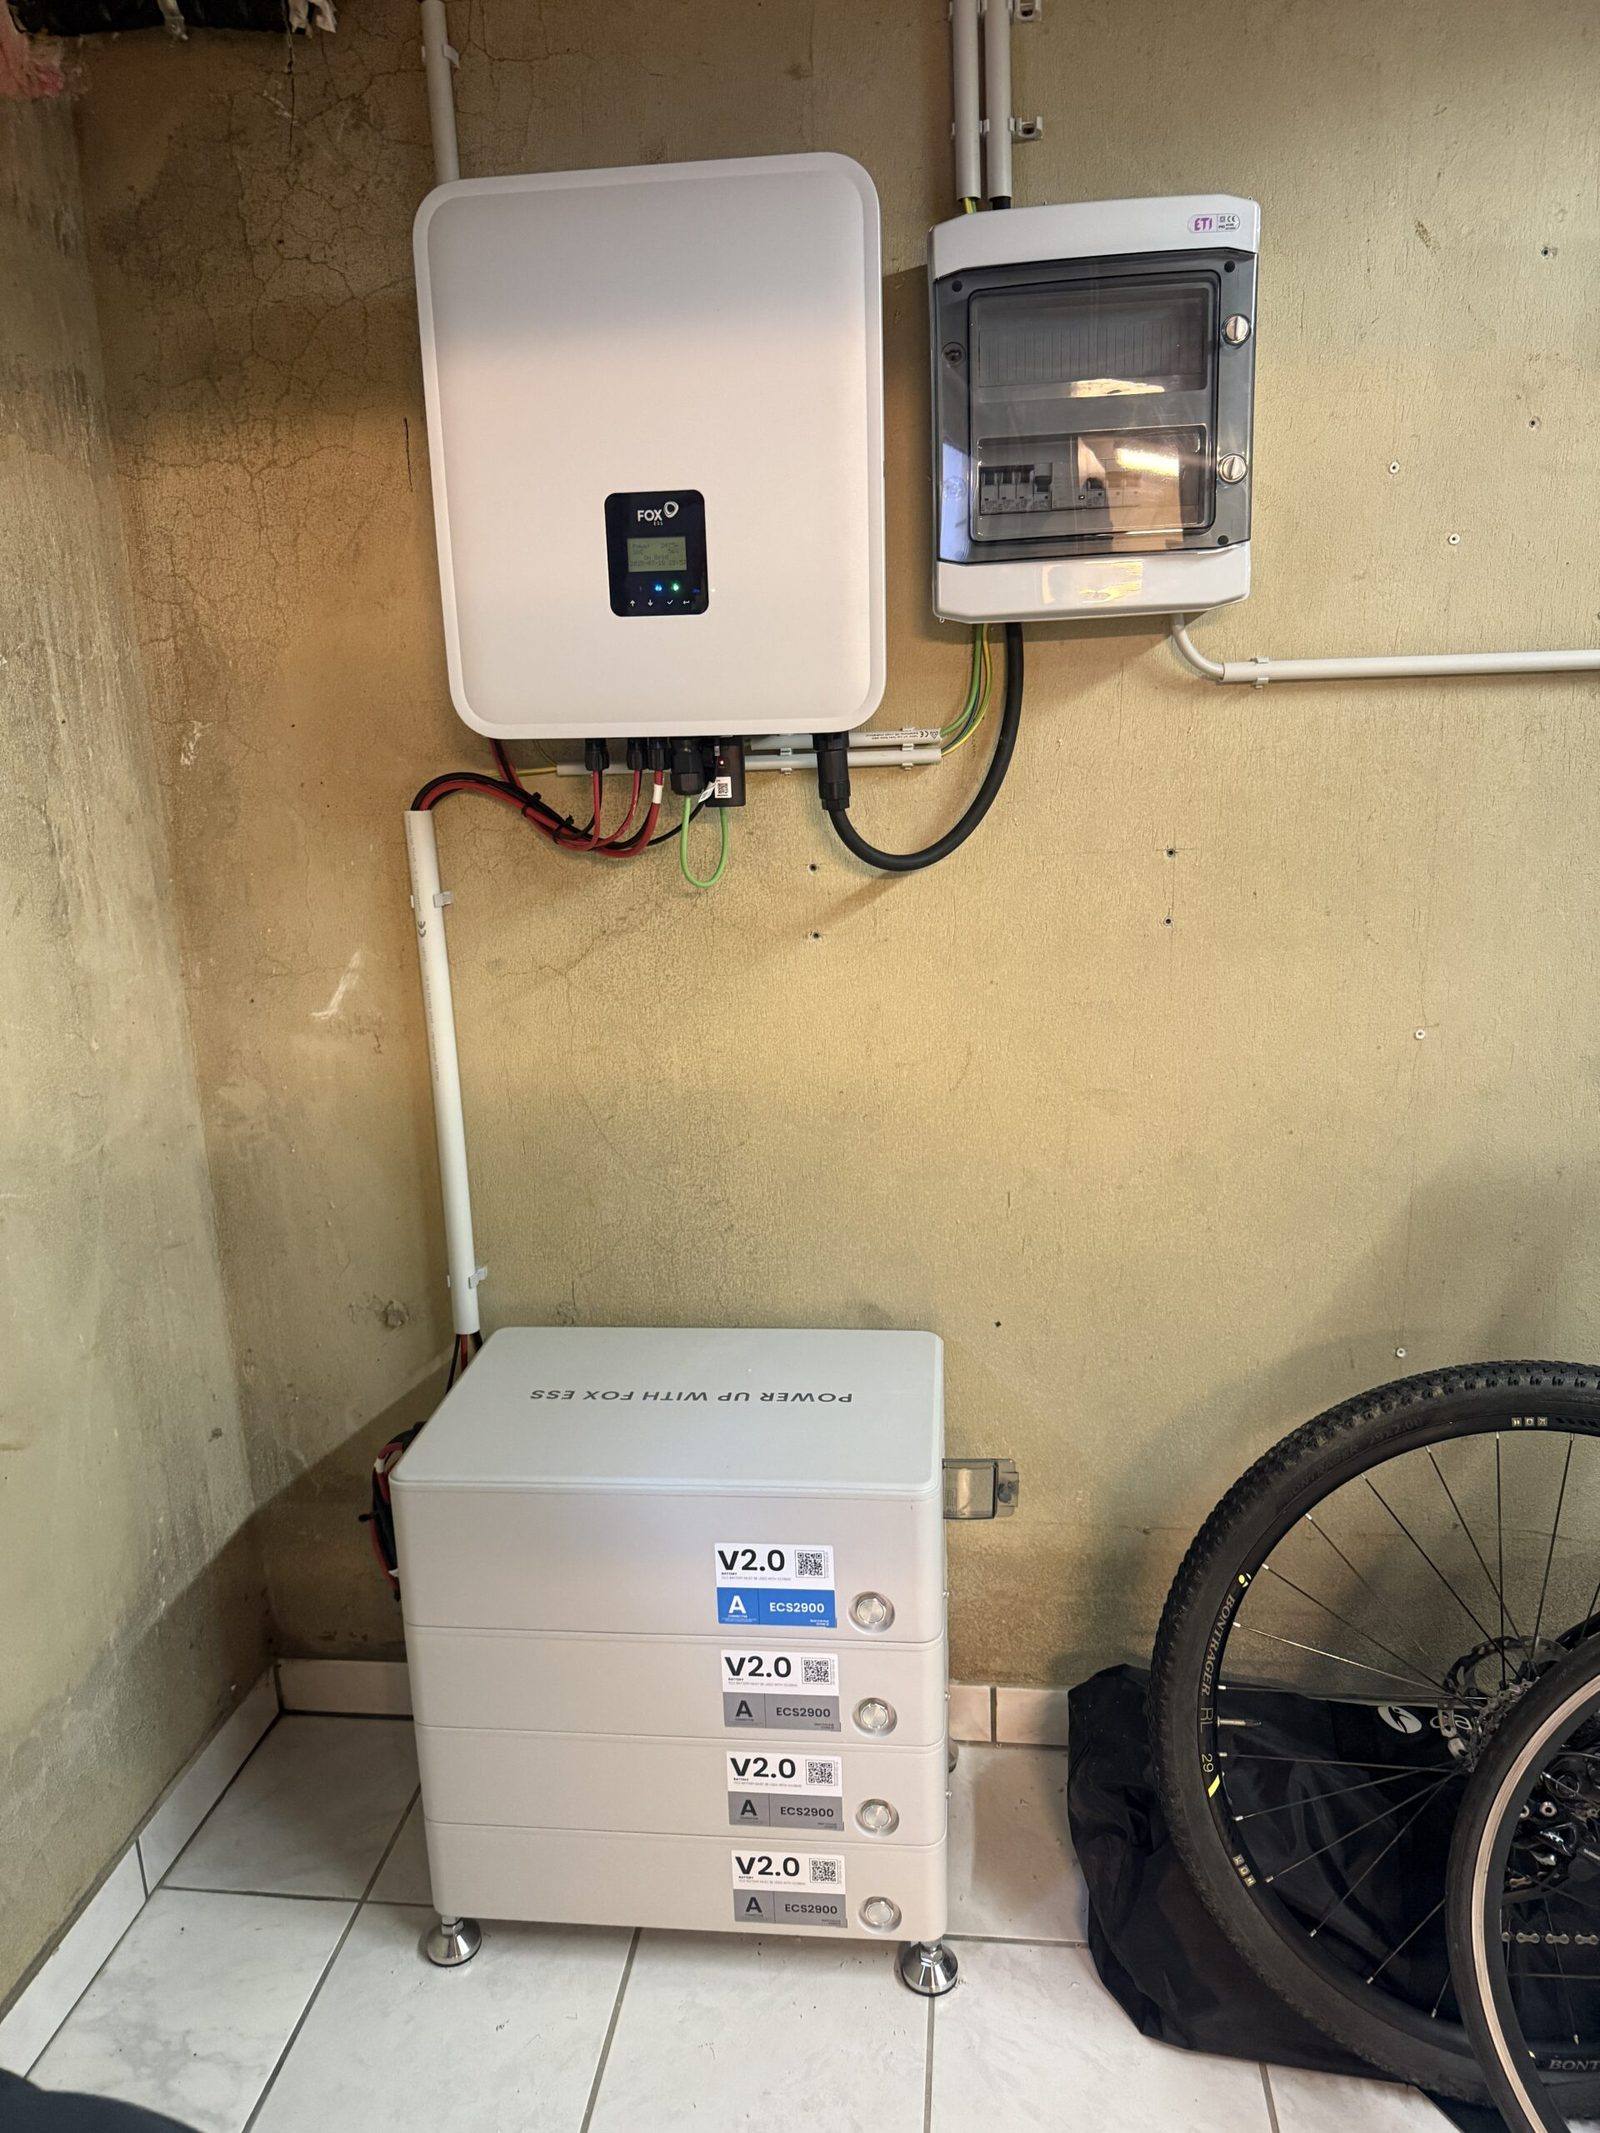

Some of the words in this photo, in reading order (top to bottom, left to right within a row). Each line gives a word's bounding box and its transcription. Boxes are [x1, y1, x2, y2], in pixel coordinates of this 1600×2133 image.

[1194, 217, 1213, 232] ETI
[637, 509, 663, 522] FOX
[530, 1389, 575, 1401] ESS
[582, 1390, 635, 1402] FOX
[642, 1390, 709, 1402] WITH
[717, 1391, 751, 1403] UP
[760, 1391, 853, 1403] POWER
[717, 1548, 785, 1572] V2.0
[728, 1594, 747, 1614] A
[769, 1602, 825, 1614] ECS2900
[1201, 1593, 1235, 1697] BONTRAGER
[724, 1655, 792, 1678] V2.0
[735, 1699, 753, 1718] A
[776, 1706, 831, 1718] ECS2900
[1200, 1707, 1214, 1734] RL
[730, 1757, 796, 1779] V2.0
[1201, 1753, 1215, 1773] 29
[740, 1799, 758, 1816] A
[780, 1806, 834, 1818] ECS2900
[735, 1855, 800, 1877] V2.0
[745, 1896, 763, 1913] A
[784, 1903, 838, 1915] ECS2900
